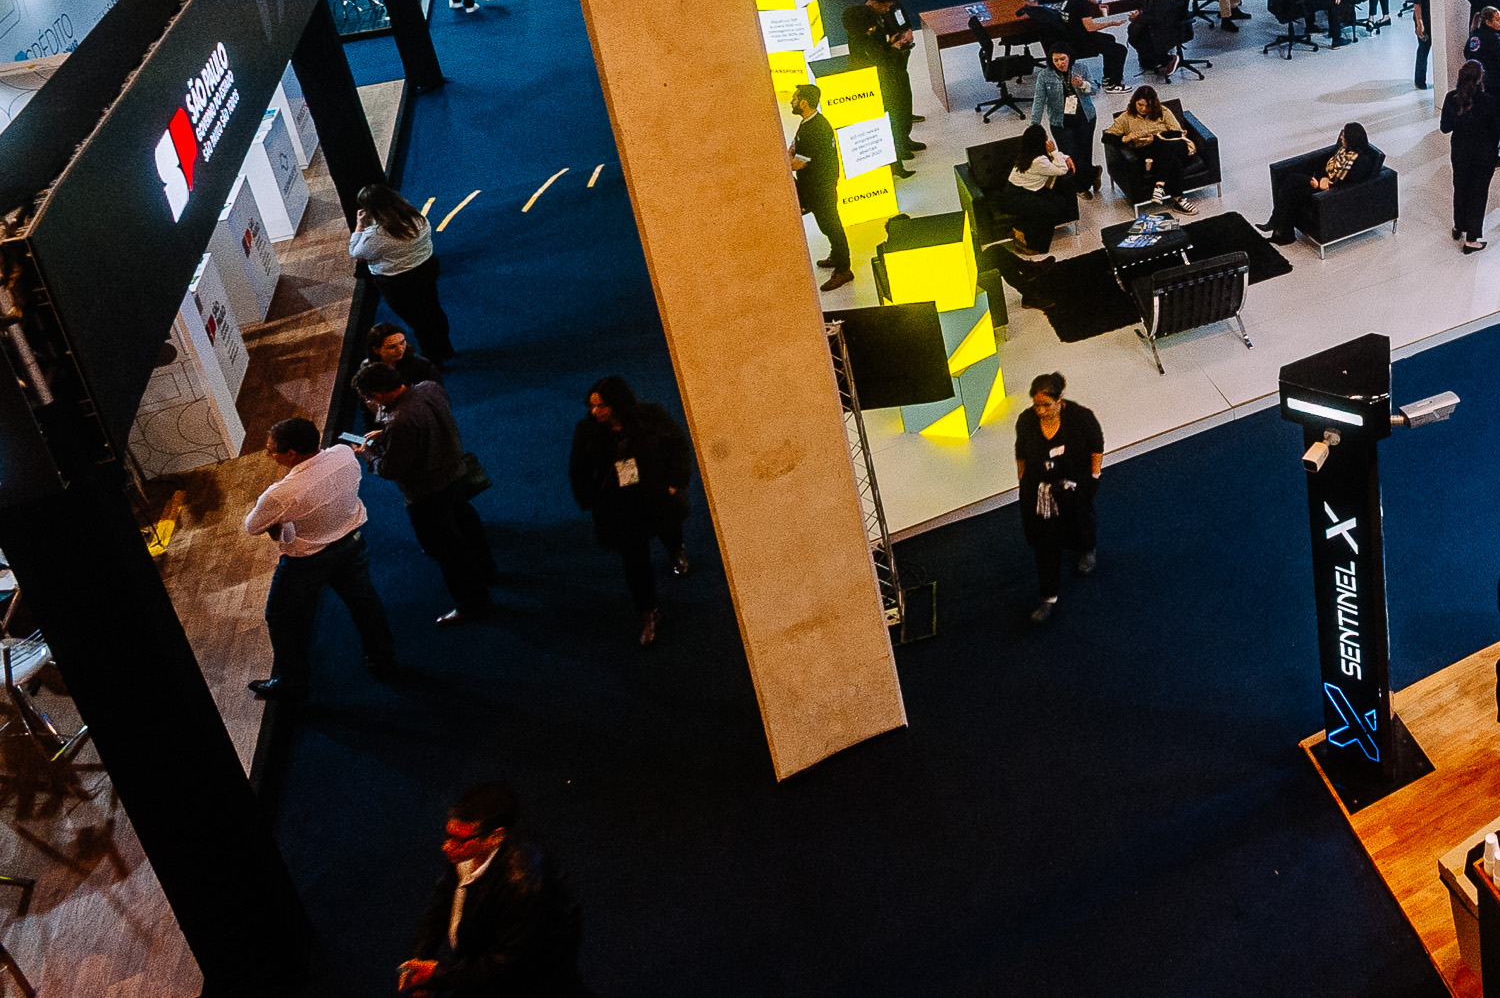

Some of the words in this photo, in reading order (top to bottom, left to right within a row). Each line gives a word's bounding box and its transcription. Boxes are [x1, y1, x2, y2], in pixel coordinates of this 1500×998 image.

[186, 78, 207, 124] SÃO
[201, 41, 229, 98] PAULO
[827, 91, 875, 106] ECONOMIA
[842, 189, 888, 204] ECONOMIA
